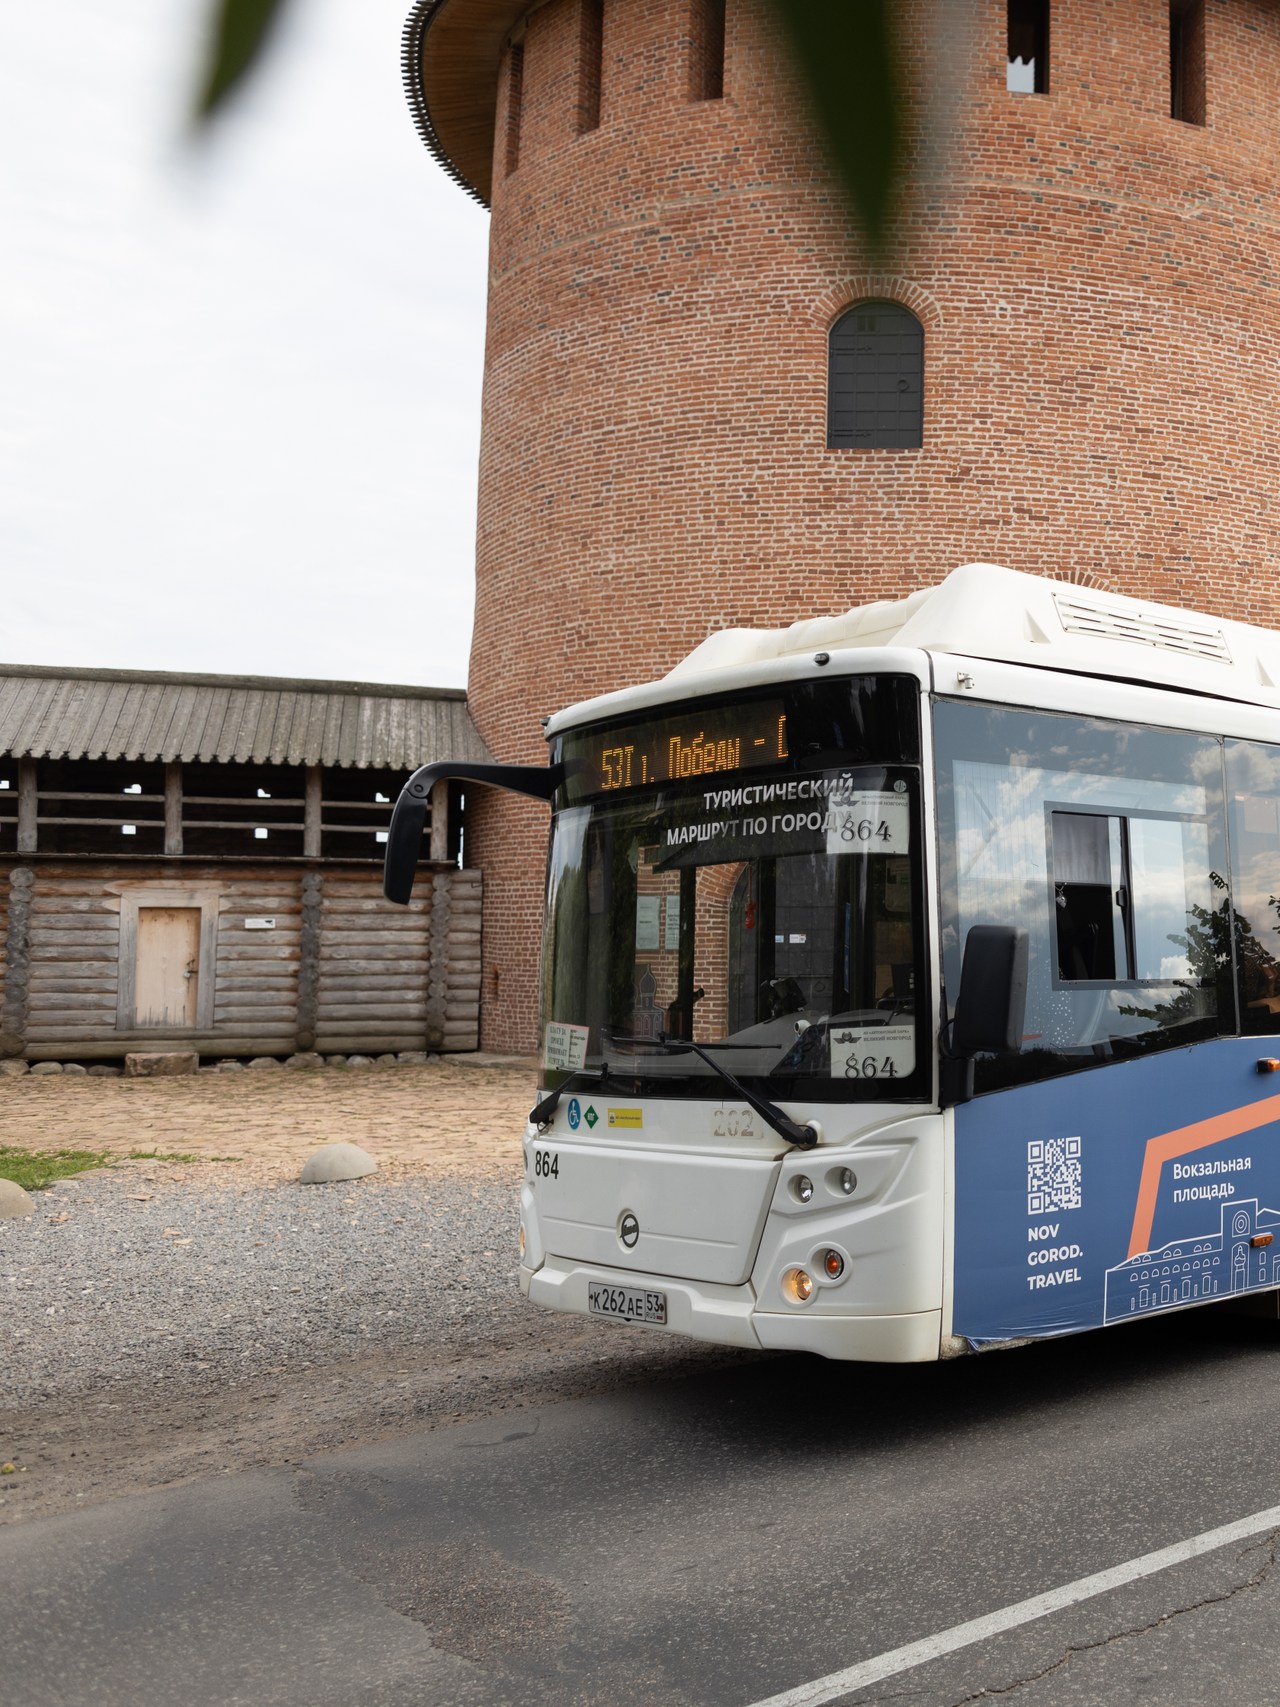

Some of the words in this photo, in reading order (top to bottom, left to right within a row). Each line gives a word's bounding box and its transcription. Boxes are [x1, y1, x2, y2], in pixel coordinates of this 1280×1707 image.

[668, 731, 740, 779] Победы
[703, 772, 854, 810] ТУРИСТИЧЕСКИЙ
[666, 818, 740, 846] МАРШРУТ
[742, 816, 768, 836] ПО
[841, 815, 892, 842] 864
[844, 1052, 898, 1079] 864
[535, 1150, 559, 1180] 864
[1172, 1156, 1253, 1181] Вокзальная
[1173, 1180, 1236, 1204] площадь
[1027, 1223, 1060, 1242] NOV
[1027, 1245, 1084, 1267] GOROD.
[1027, 1267, 1082, 1291] TRAVEL
[646, 1293, 660, 1312] 53
